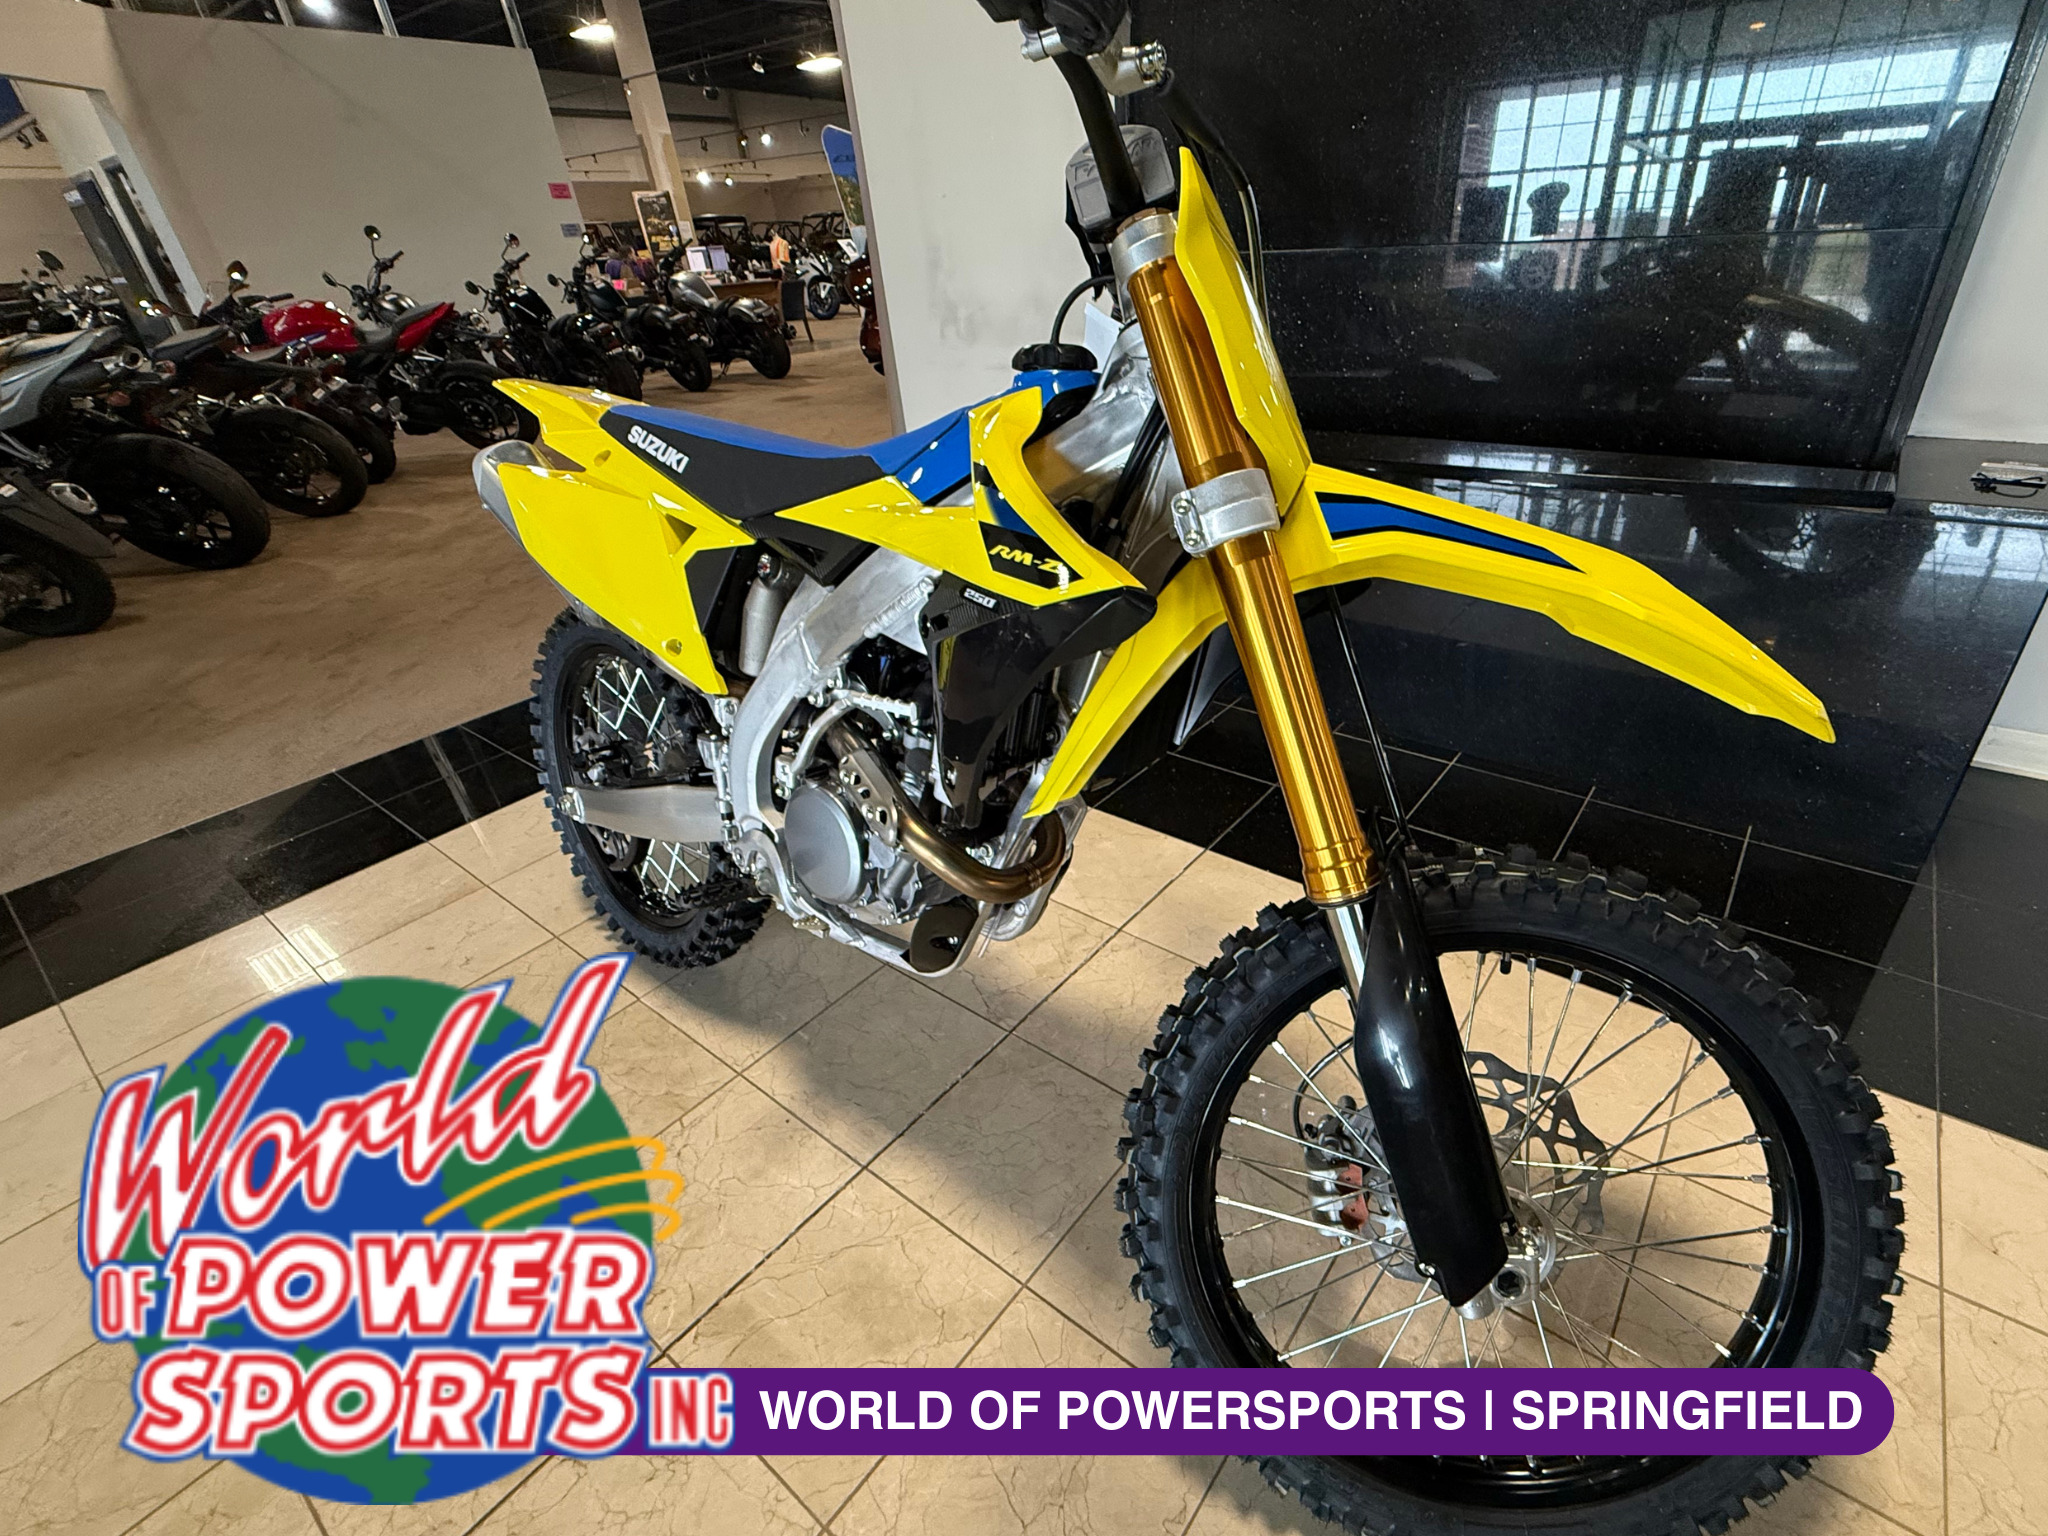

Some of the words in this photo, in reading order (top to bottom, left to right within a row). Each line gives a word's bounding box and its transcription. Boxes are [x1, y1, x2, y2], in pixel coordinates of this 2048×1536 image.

[627, 425, 690, 474] SUZUKI
[988, 544, 1064, 574] RM-Z
[964, 587, 997, 609] 250
